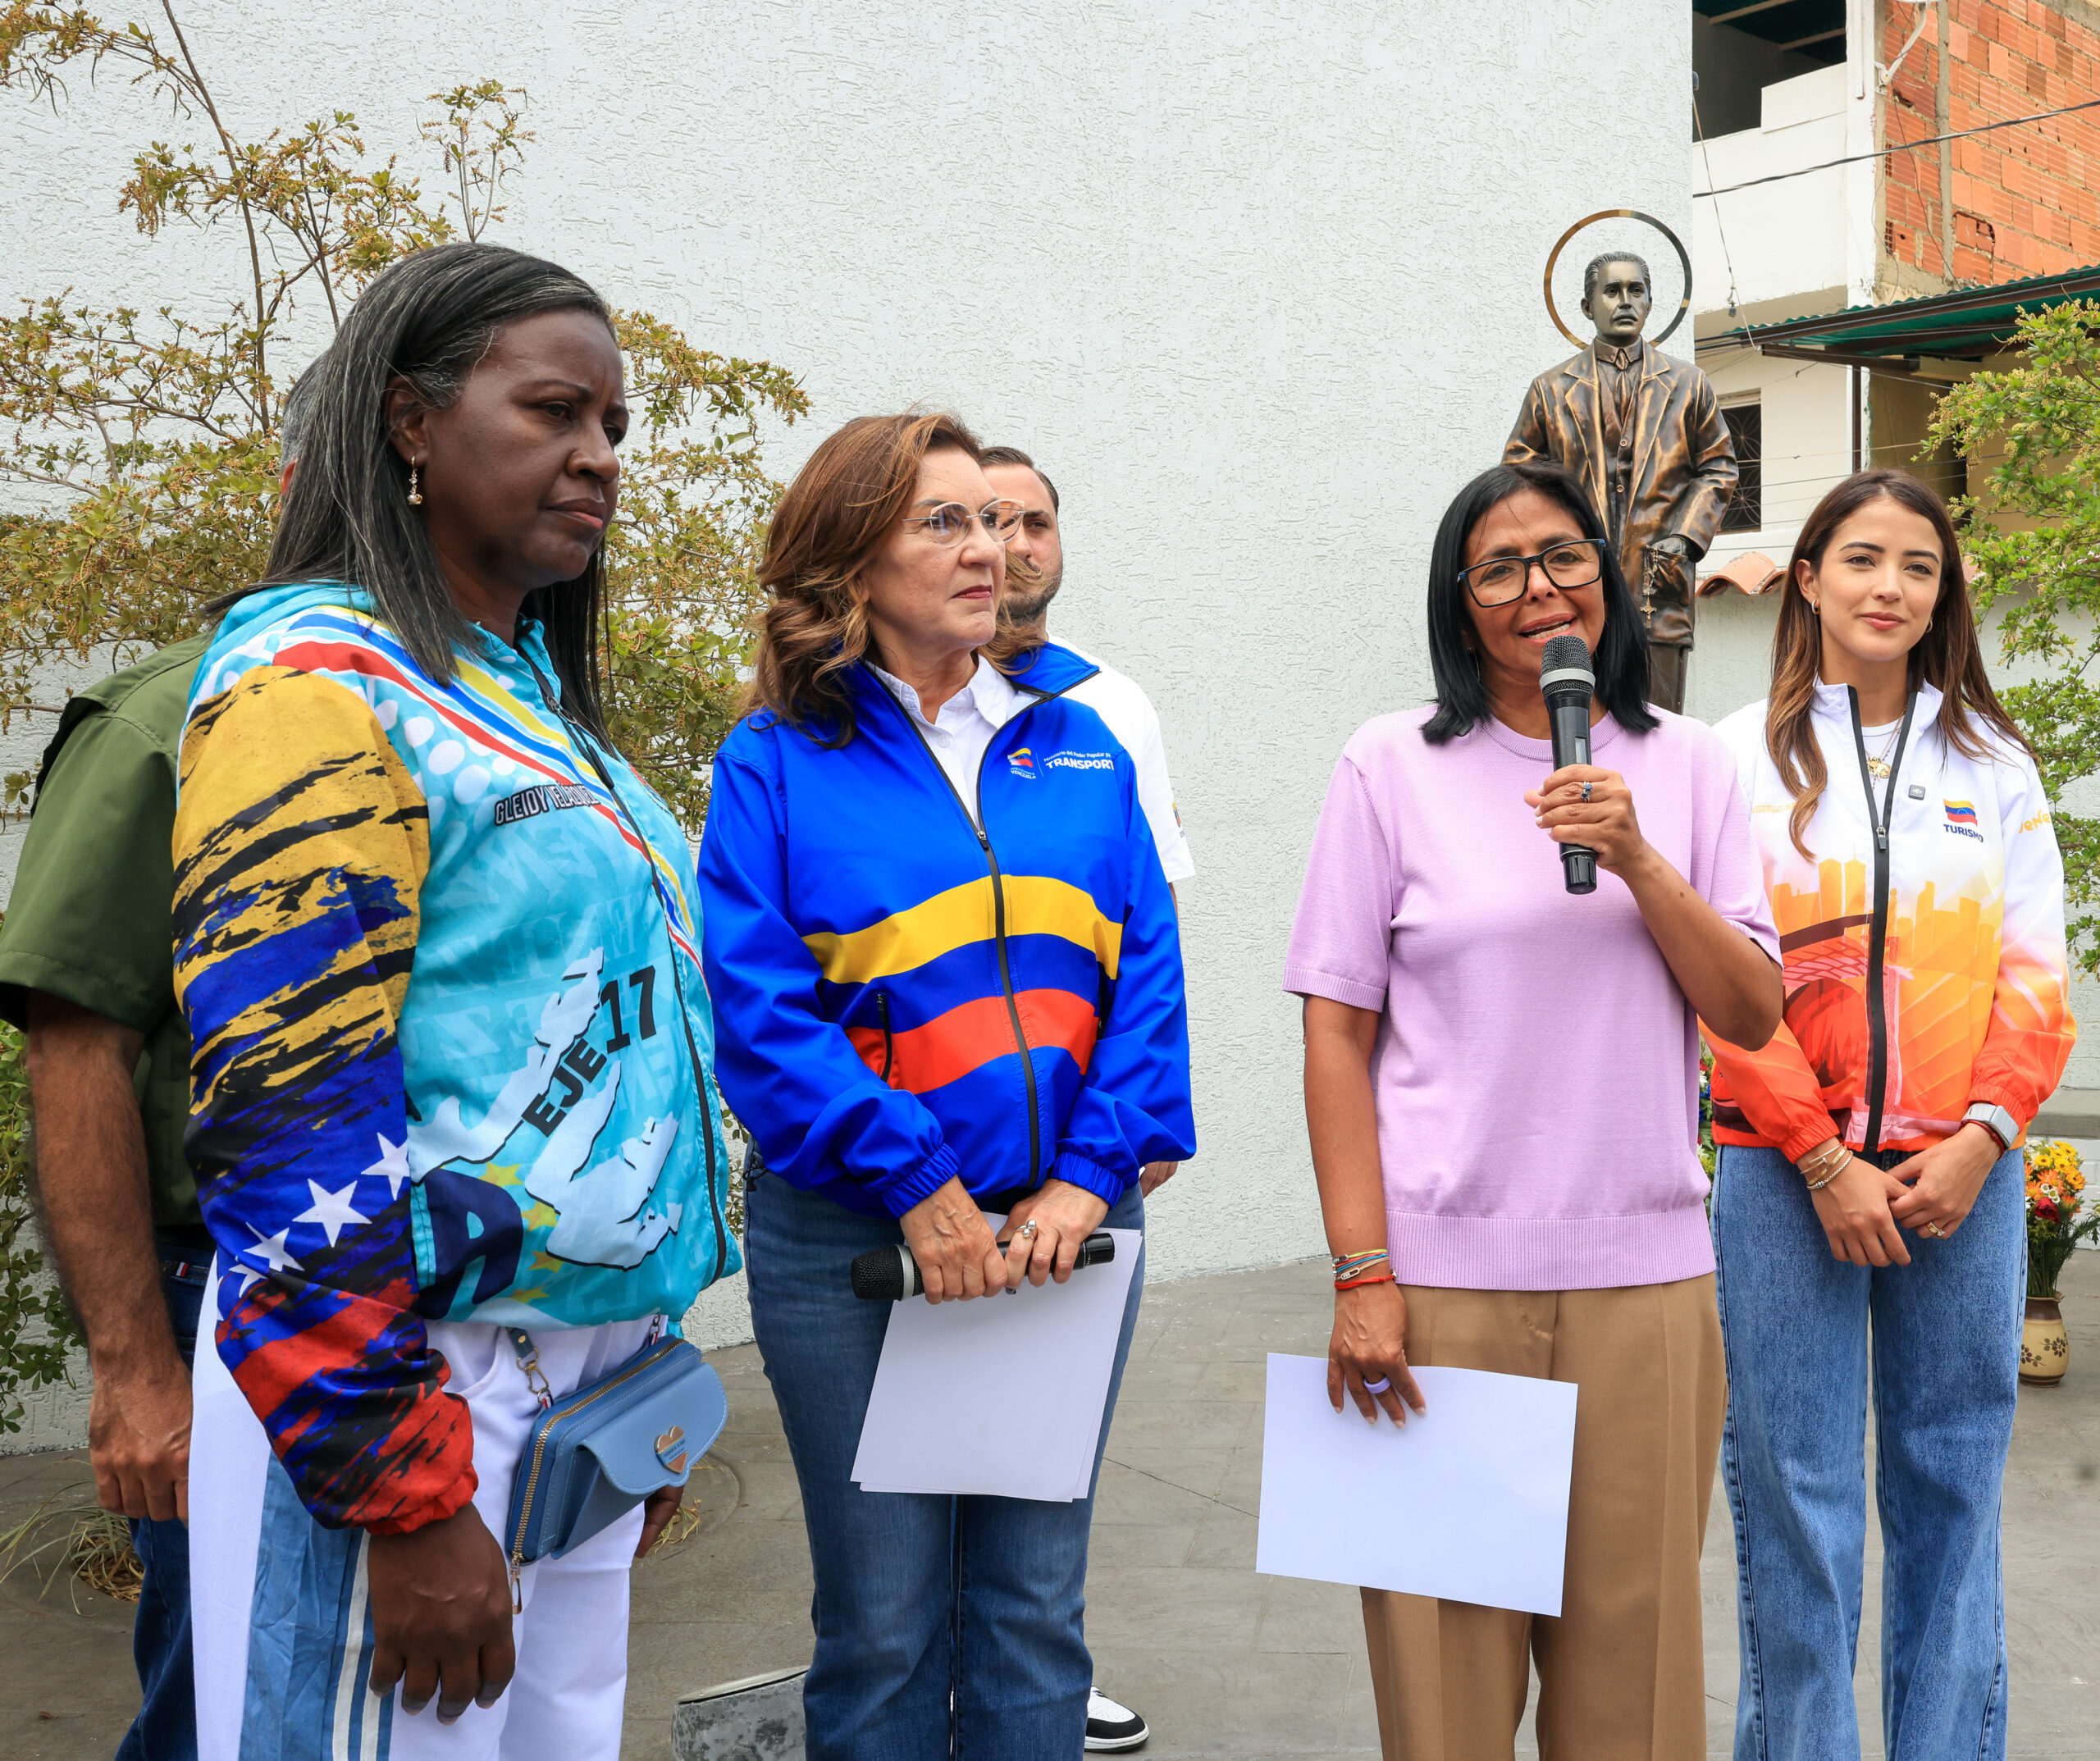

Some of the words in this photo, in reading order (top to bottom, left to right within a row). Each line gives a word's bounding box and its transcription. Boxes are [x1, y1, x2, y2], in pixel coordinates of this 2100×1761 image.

[1043, 750, 1066, 762] Ministerio
[495, 785, 549, 825] GLEIDY
[1942, 823, 1984, 843] TURISMO
[521, 1038, 607, 1138] EJE
[600, 965, 657, 1054] 17
